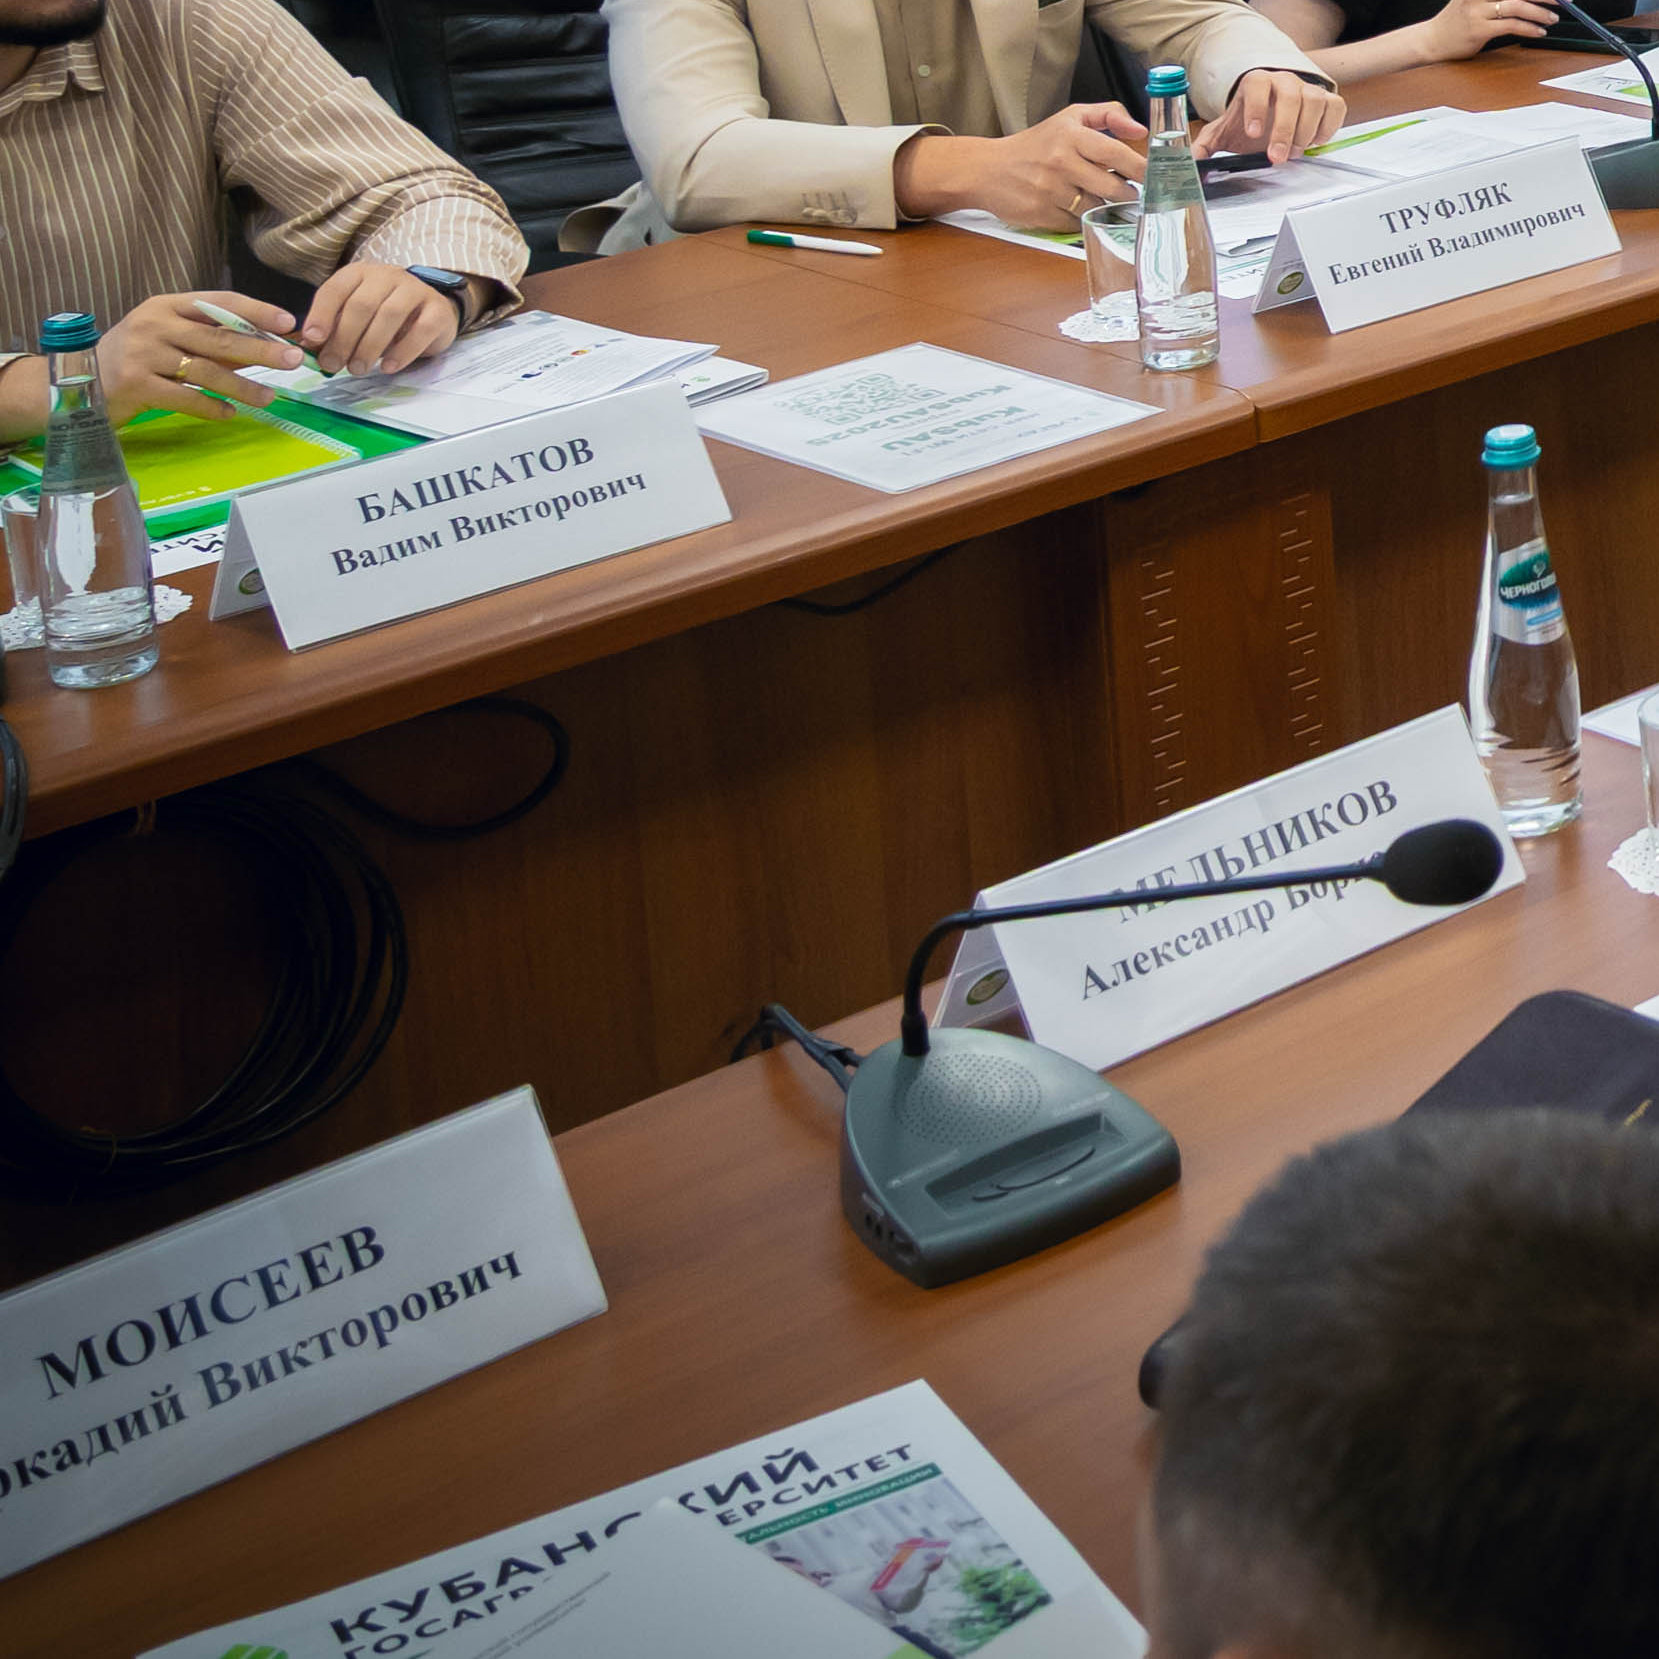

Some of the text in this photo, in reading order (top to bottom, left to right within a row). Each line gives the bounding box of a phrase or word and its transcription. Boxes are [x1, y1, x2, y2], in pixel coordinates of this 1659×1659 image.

[1328, 202, 1587, 286] Евгений Владимирович
[1379, 182, 1513, 234] ТРУФЛЯК
[881, 405, 1028, 452] KubSAU
[330, 471, 648, 578] Вадим Викторович
[355, 436, 595, 525] БАШКАТОВ
[1081, 896, 1276, 1001] Александр
[36, 1224, 387, 1400] МОИСЕЕВ
[196, 1250, 523, 1411] Викторович
